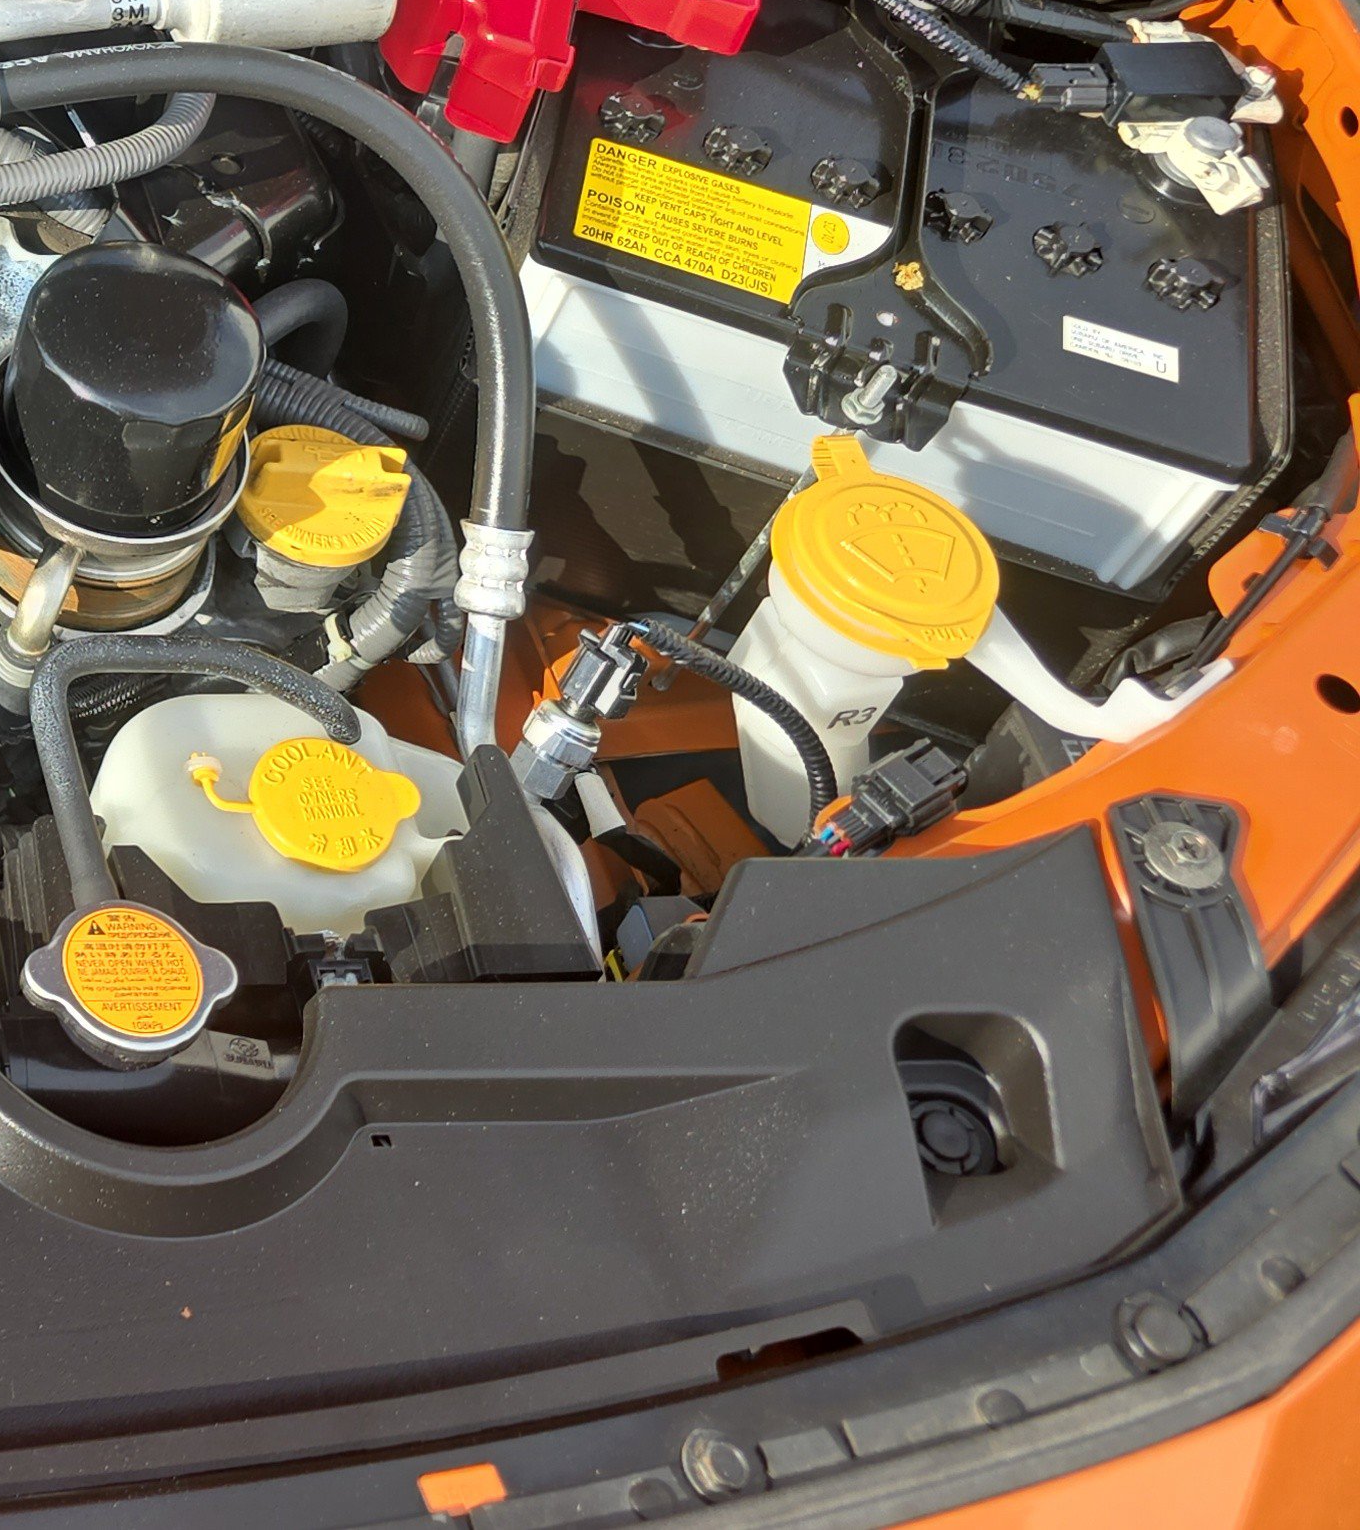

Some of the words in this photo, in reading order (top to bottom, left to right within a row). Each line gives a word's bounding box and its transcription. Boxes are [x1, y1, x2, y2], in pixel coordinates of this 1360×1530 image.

[62, 42, 160, 58] YOKOHAMA
[597, 143, 657, 169] DANGER
[662, 164, 709, 184] EXPLOSIVE
[712, 179, 741, 194] GASES
[587, 188, 646, 215] POISON
[654, 211, 690, 228] CAUSES
[692, 223, 726, 240] SEVERE
[728, 234, 759, 250] BURNS
[635, 192, 657, 205] KEEP
[659, 199, 681, 212] VENT
[683, 207, 707, 220] CAPS
[710, 215, 734, 229] TIGHT
[736, 224, 754, 236] AND
[756, 230, 784, 246] LEVEL
[582, 224, 614, 243] 20HR
[617, 235, 648, 254] 62Ah
[654, 247, 683, 265] CCA
[684, 257, 716, 275] 470A
[721, 268, 774, 295] D23(JIS)
[628, 227, 650, 241] KEEP
[652, 235, 669, 247] OUT
[671, 241, 684, 251] OF
[686, 246, 716, 262] REACH
[718, 255, 730, 266] OF
[732, 260, 777, 281] CHILDREN
[1155, 360, 1167, 373] U
[261, 507, 284, 529] SEE
[285, 524, 342, 550] OWNER'S
[343, 517, 387, 550] MANUAL
[921, 626, 975, 643] PULL
[826, 706, 878, 730] R3
[261, 742, 374, 785] COOLANT
[301, 775, 332, 791] SEE
[301, 803, 361, 822] MANUAL
[105, 923, 158, 931] WARNING
[101, 1002, 182, 1011] AVERTISSEMENT
[225, 1053, 275, 1069] SUBARU
